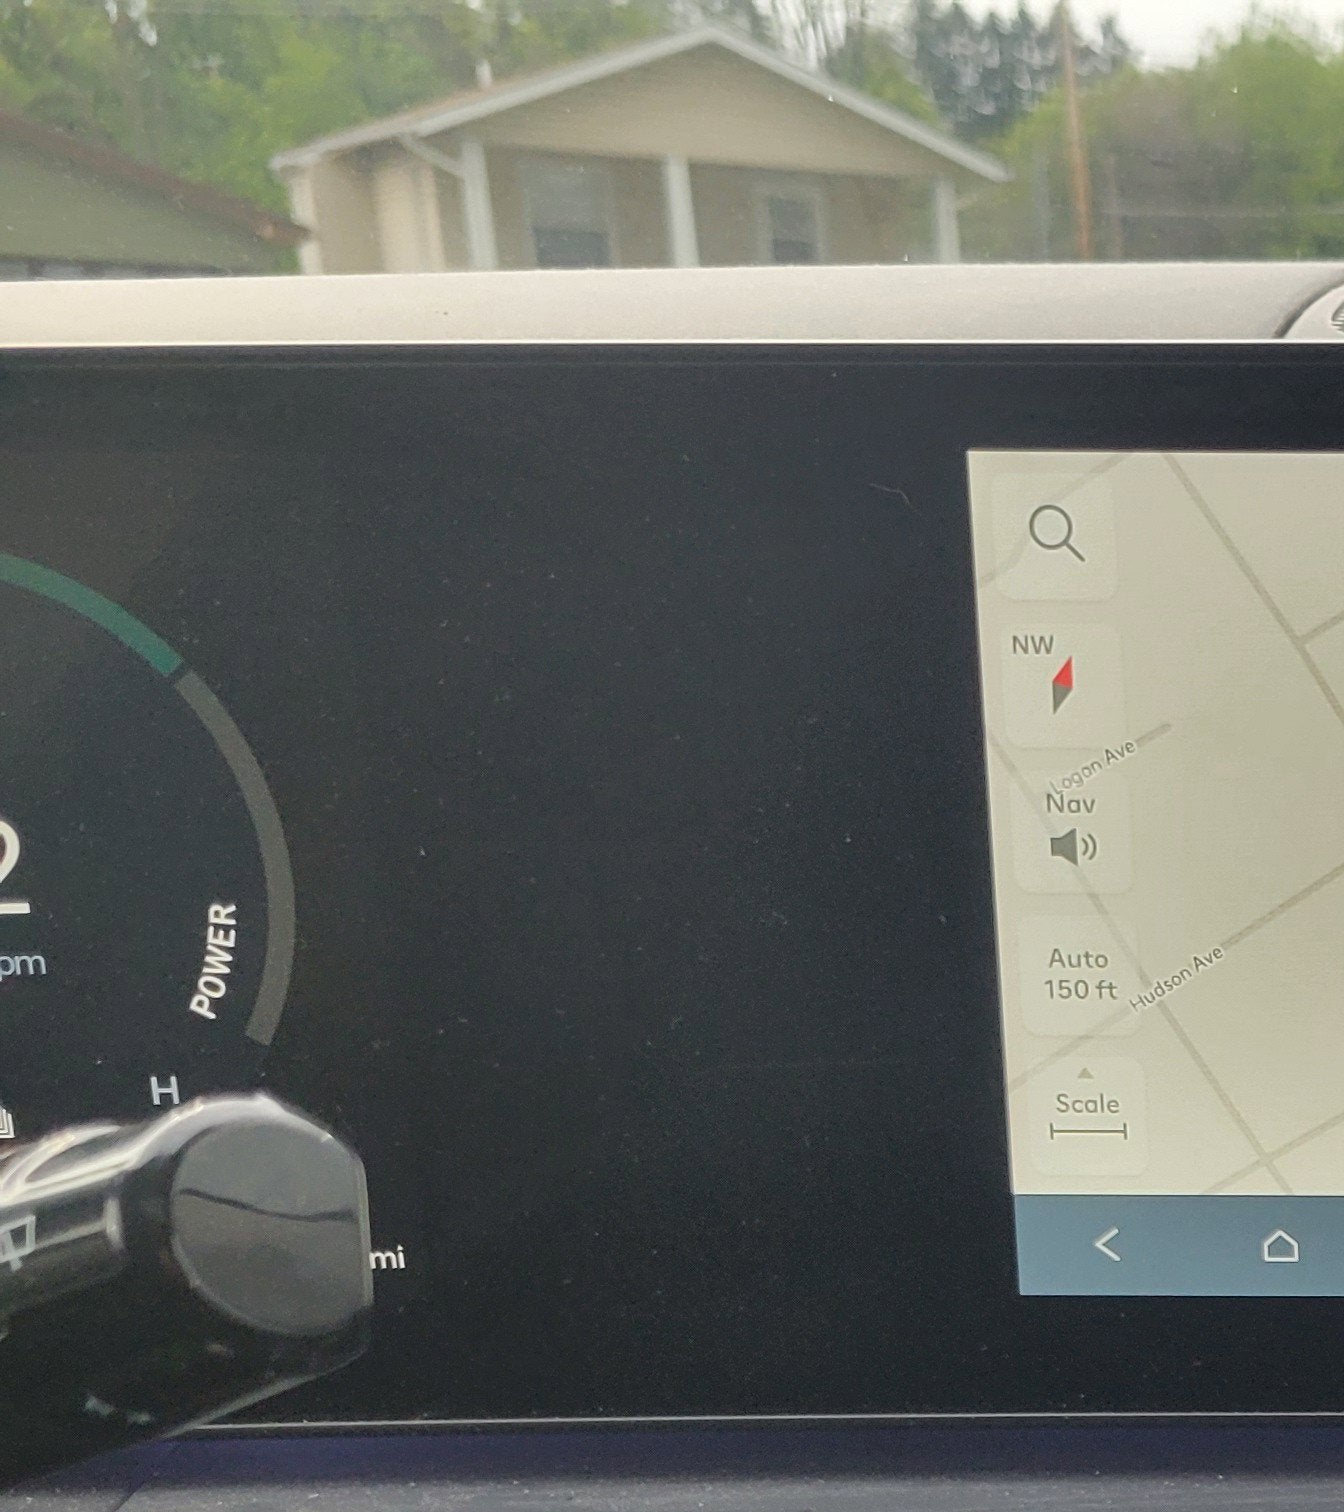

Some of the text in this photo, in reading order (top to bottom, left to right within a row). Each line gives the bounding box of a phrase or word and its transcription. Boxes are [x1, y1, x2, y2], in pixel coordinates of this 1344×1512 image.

[1011, 634, 1054, 655] NW
[1050, 740, 1136, 795] Logan Ave
[1046, 792, 1096, 814] Nav
[189, 902, 237, 1020] POWER
[1049, 947, 1109, 969] Auto
[1044, 979, 1119, 1000] 150 ft
[1129, 946, 1225, 1013] Hudson Ave
[150, 1075, 181, 1106] H
[1055, 1092, 1121, 1114] Scale
[369, 1244, 406, 1270] mi
